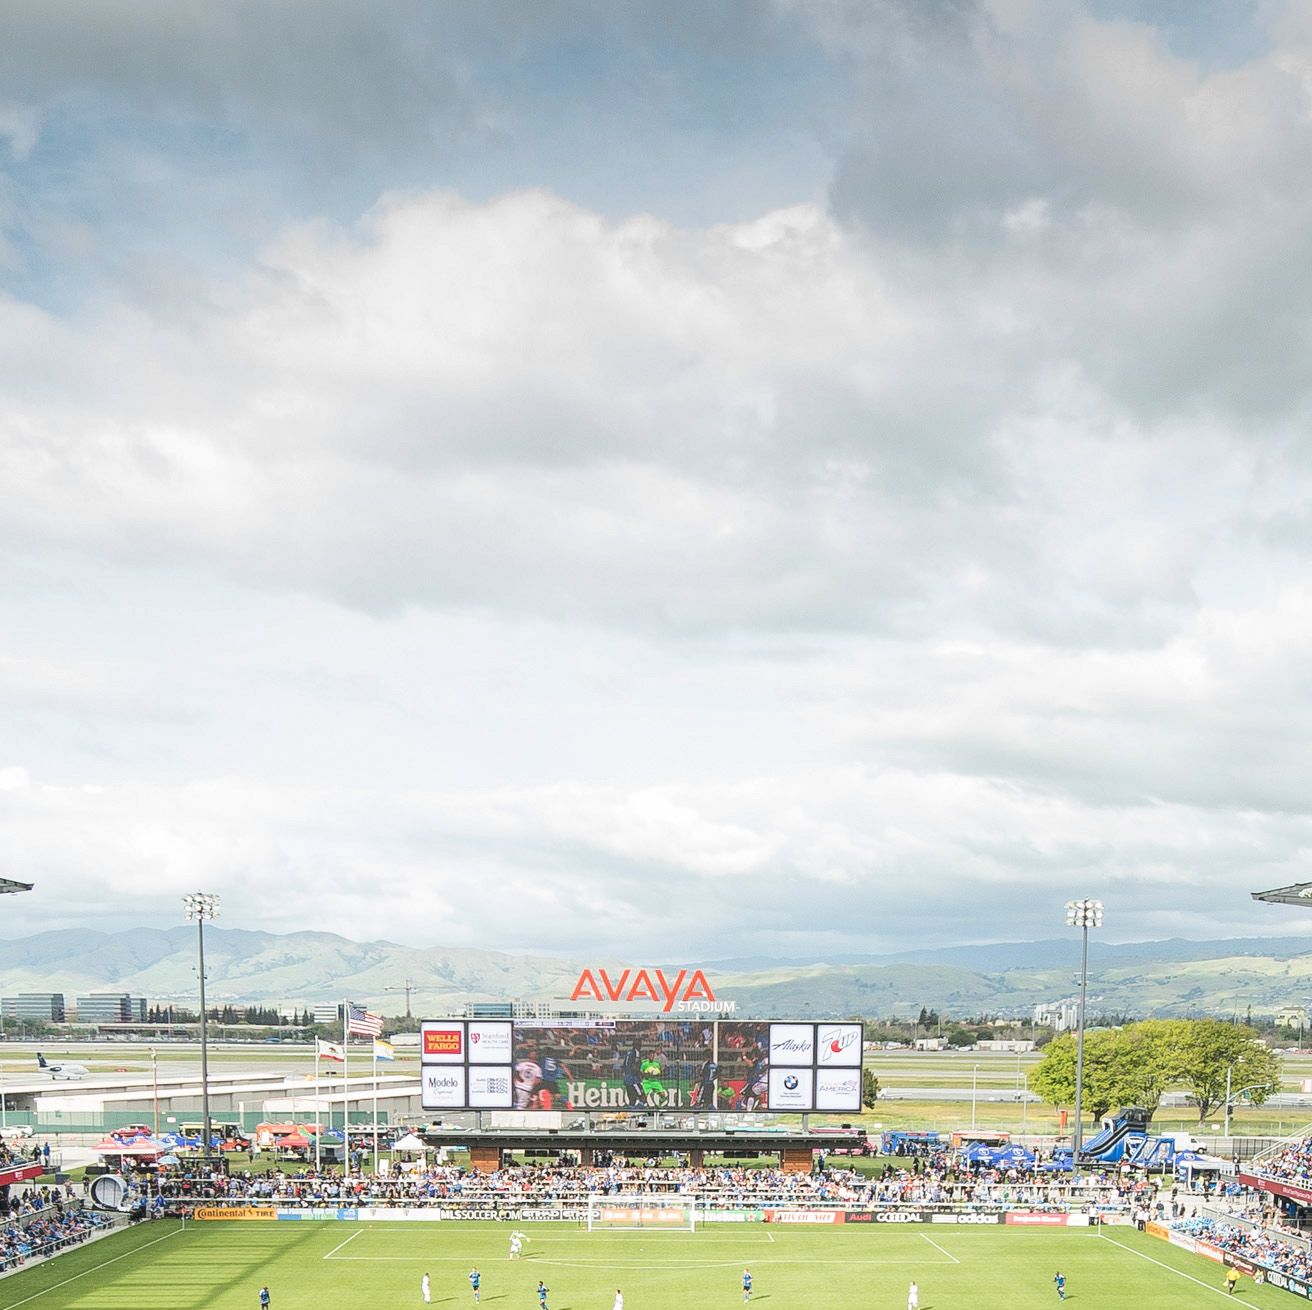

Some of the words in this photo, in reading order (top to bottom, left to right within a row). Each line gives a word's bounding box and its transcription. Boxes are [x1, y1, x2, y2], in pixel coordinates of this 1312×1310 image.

[570, 968, 715, 1013] AVAYA
[678, 1002, 735, 1012] STADIUM
[427, 1034, 460, 1042] WELLS
[429, 1077, 458, 1089] Modelo
[197, 1208, 246, 1219] Continental
[849, 1213, 872, 1222] Audi
[957, 1213, 999, 1225] adidas
